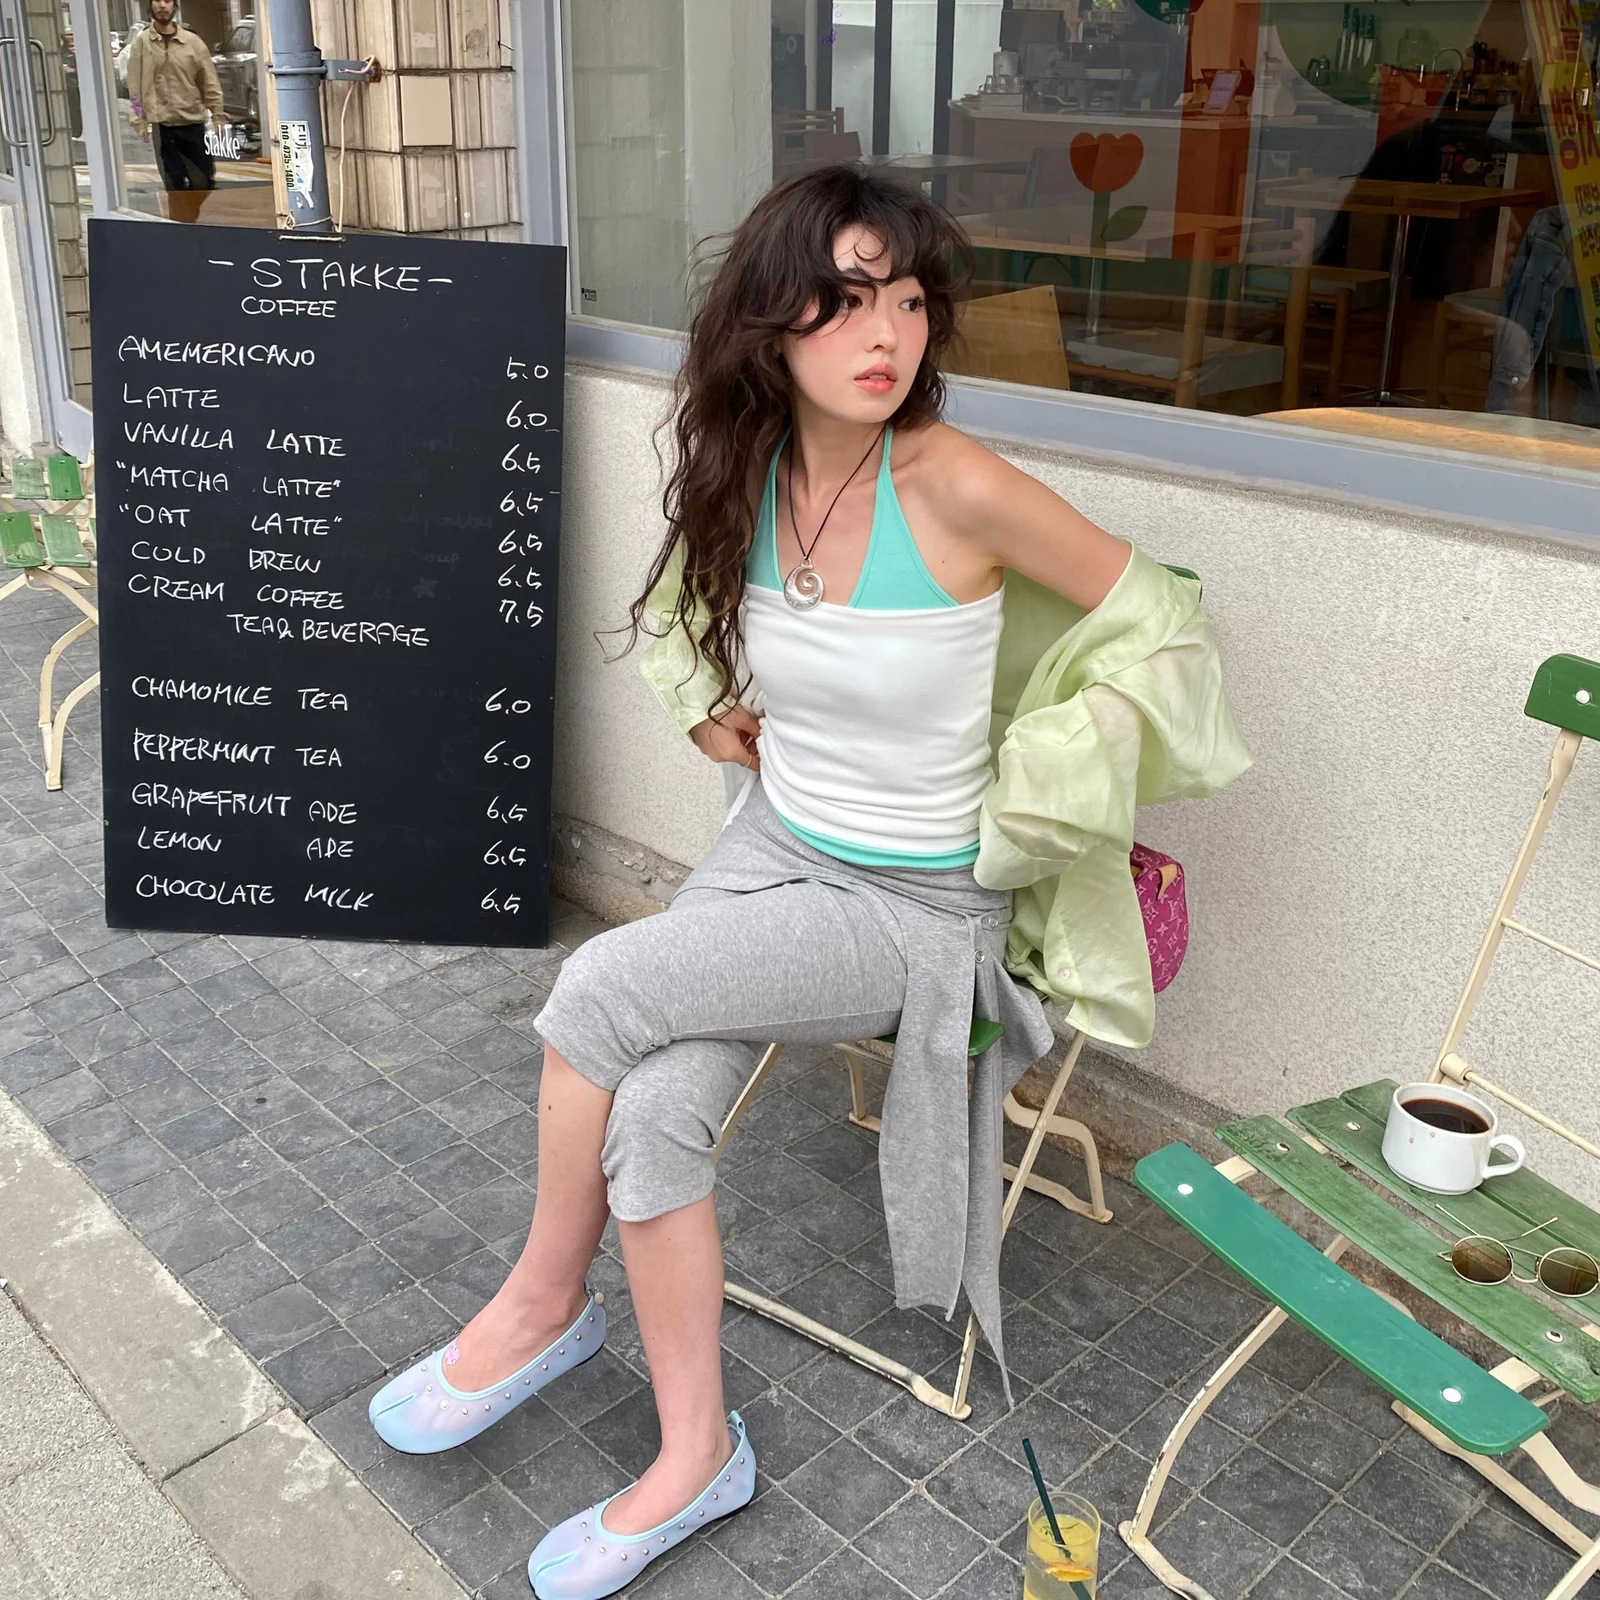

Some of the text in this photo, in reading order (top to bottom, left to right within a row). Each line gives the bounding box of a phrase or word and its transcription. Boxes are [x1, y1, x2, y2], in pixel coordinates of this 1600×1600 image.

[204, 124, 241, 160] stakke
[241, 296, 337, 317] COFFEE
[119, 336, 548, 379] AMEMERICANO 5.0
[124, 383, 547, 429] LATTE 6.0
[125, 422, 540, 473] VANILLA LATTE 6.5
[500, 491, 543, 516] 6.5
[498, 530, 542, 555] 6.5
[132, 541, 542, 589] COLD BREW 6.5
[128, 574, 543, 627] CREAM COFFEE 7.5
[303, 619, 429, 646] BEVERAGE
[132, 676, 531, 714] CHAMOMILE TEA 6.0
[133, 728, 530, 769] PEPPERMINT TEA 6.0
[132, 783, 527, 824] GRAPEFRUIT ADE 6.5
[138, 826, 526, 866] LEMON ADE 6.5
[136, 875, 520, 914] CHOCOLATE MILK 6.5
